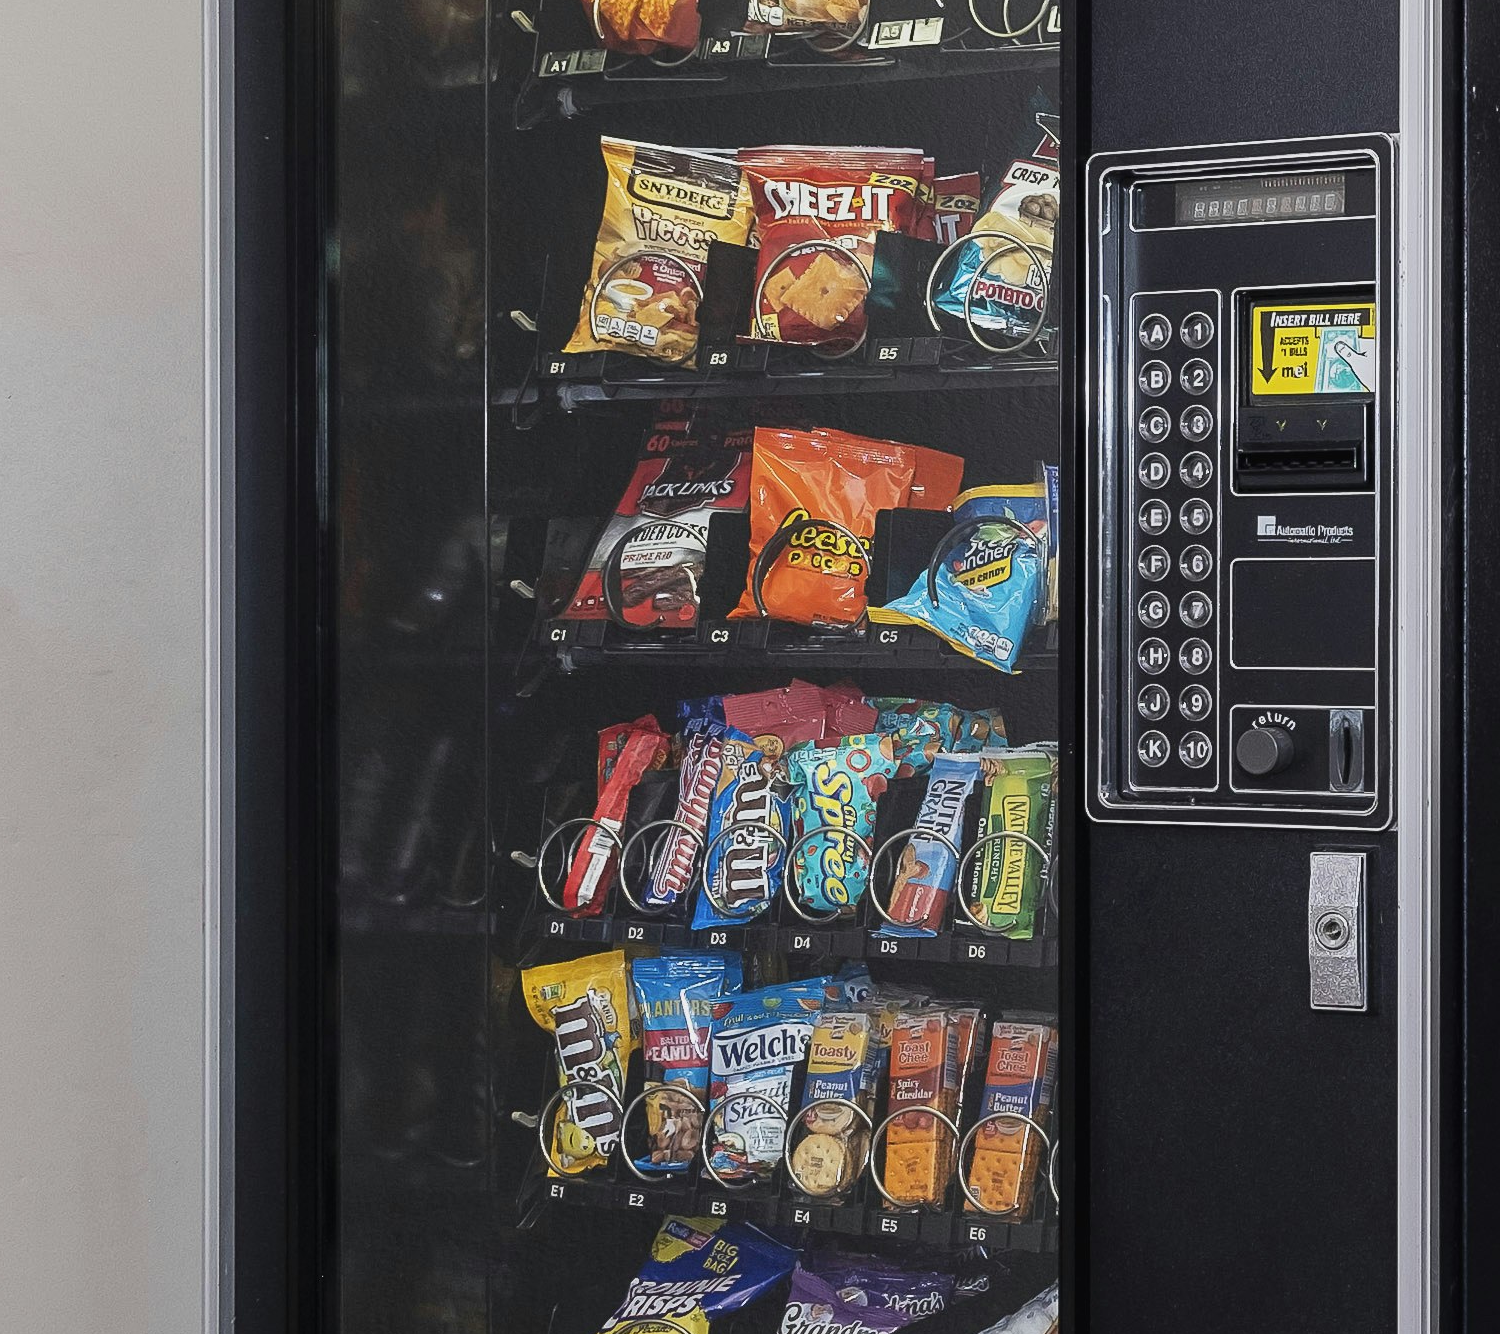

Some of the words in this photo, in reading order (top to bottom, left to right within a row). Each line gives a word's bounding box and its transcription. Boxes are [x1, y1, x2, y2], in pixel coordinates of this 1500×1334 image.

[881, 25, 901, 40] A5
[711, 39, 732, 55] A3
[550, 60, 569, 74] A1
[1011, 167, 1049, 186] CRISP
[631, 203, 719, 252] Pieces
[673, 215, 706, 227] Pretzel
[659, 264, 686, 278] Onion
[975, 280, 1035, 310] POTATO
[1270, 312, 1307, 327] INSERT
[1309, 313, 1331, 326] BILL
[1334, 313, 1362, 325] HERE
[1149, 323, 1165, 344] A
[1193, 322, 1203, 341] 1
[709, 351, 728, 366] B3
[879, 346, 898, 361] B5
[550, 361, 567, 375] B1
[1150, 370, 1164, 390] B
[1192, 369, 1205, 387] 2
[1149, 416, 1164, 436] C
[1192, 415, 1205, 434] 3
[645, 434, 671, 453] 60
[1150, 462, 1164, 481] D
[1191, 462, 1205, 481] 4
[638, 481, 679, 503] JACK
[1150, 508, 1164, 528] E
[1192, 508, 1205, 527] 5
[1276, 525, 1316, 536] Automatic
[1317, 524, 1354, 536] Products
[622, 551, 654, 563] PRIME
[1150, 555, 1163, 573] F
[1192, 555, 1204, 573] 6
[976, 565, 1008, 584] CANDY
[1149, 601, 1164, 620] G
[1191, 601, 1204, 619] 7
[550, 628, 567, 643] C1
[710, 628, 729, 644] C3
[879, 628, 898, 644] C5
[1149, 648, 1164, 666] H
[1191, 647, 1204, 666] 8
[1150, 694, 1162, 712] J
[1191, 693, 1203, 712] 9
[1250, 710, 1297, 732] return
[1149, 739, 1163, 759] K
[1187, 740, 1207, 760] 10
[812, 762, 854, 905] Spree
[990, 835, 1003, 883] RUNCHY
[996, 858, 1027, 911] VALLEY
[551, 921, 566, 935] D1
[628, 927, 645, 940] D2
[711, 932, 728, 946] D3
[794, 935, 811, 949] D4
[880, 940, 898, 954] D5
[968, 945, 986, 959] D6
[716, 1027, 813, 1069] Welch's
[812, 1042, 858, 1061] Toasty
[897, 1040, 932, 1054] Toast
[897, 1051, 930, 1065] Chee
[997, 1047, 1031, 1063] Toast
[996, 1060, 1028, 1074] Chee
[815, 1078, 849, 1092] Peanut
[896, 1078, 920, 1092] Spicy
[813, 1088, 845, 1100] Butter
[896, 1087, 934, 1101] Cheddar
[994, 1091, 1029, 1105] Peanut
[993, 1101, 1025, 1114] Butter
[551, 1184, 565, 1198] E1
[628, 1193, 645, 1208] E2
[711, 1201, 728, 1215] E3
[794, 1210, 811, 1225] E4
[881, 1218, 898, 1233] E5
[968, 1227, 987, 1242] E6
[712, 1238, 740, 1258] BIG
[702, 1255, 740, 1275] BAG!
